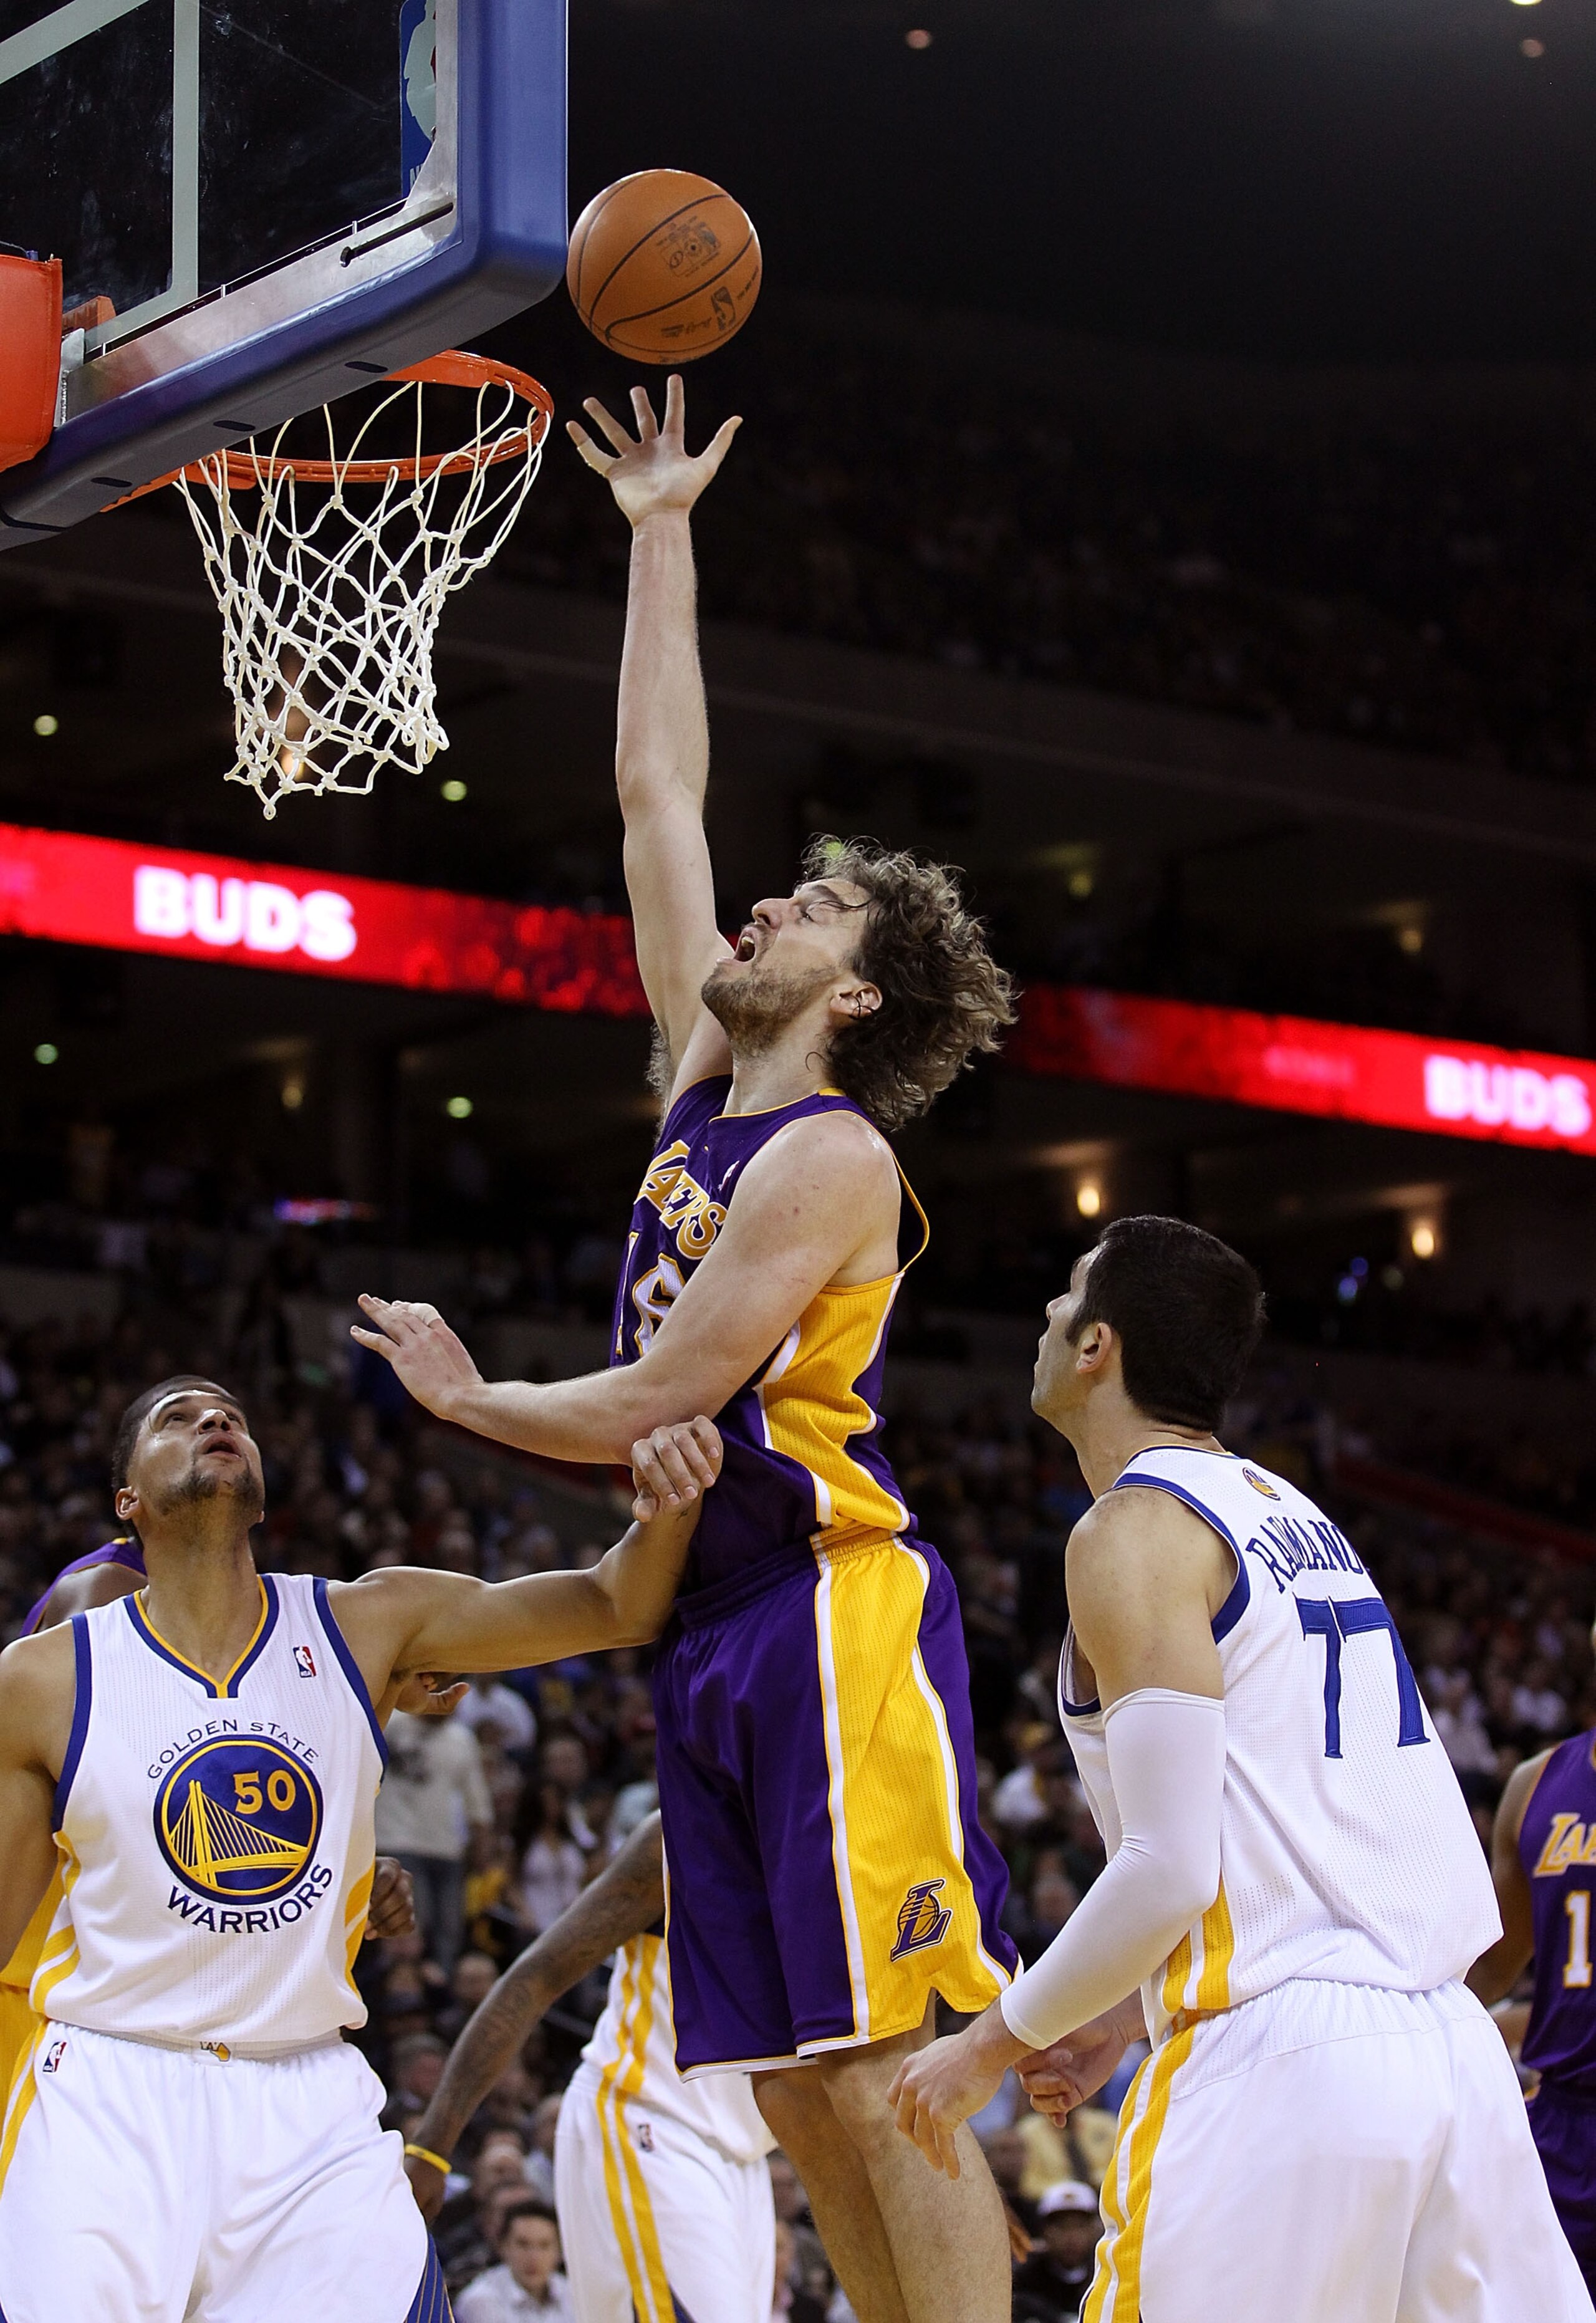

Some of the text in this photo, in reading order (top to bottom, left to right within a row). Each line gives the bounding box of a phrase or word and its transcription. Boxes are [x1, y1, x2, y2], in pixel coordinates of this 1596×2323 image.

[133, 865, 357, 961] BUDS
[1424, 1054, 1592, 1137] BUDS
[1292, 1592, 1431, 1759] 77
[148, 1719, 319, 1779] GOLDEN STATE
[233, 1769, 296, 1815] 50
[167, 1864, 333, 1933] WARRIORS
